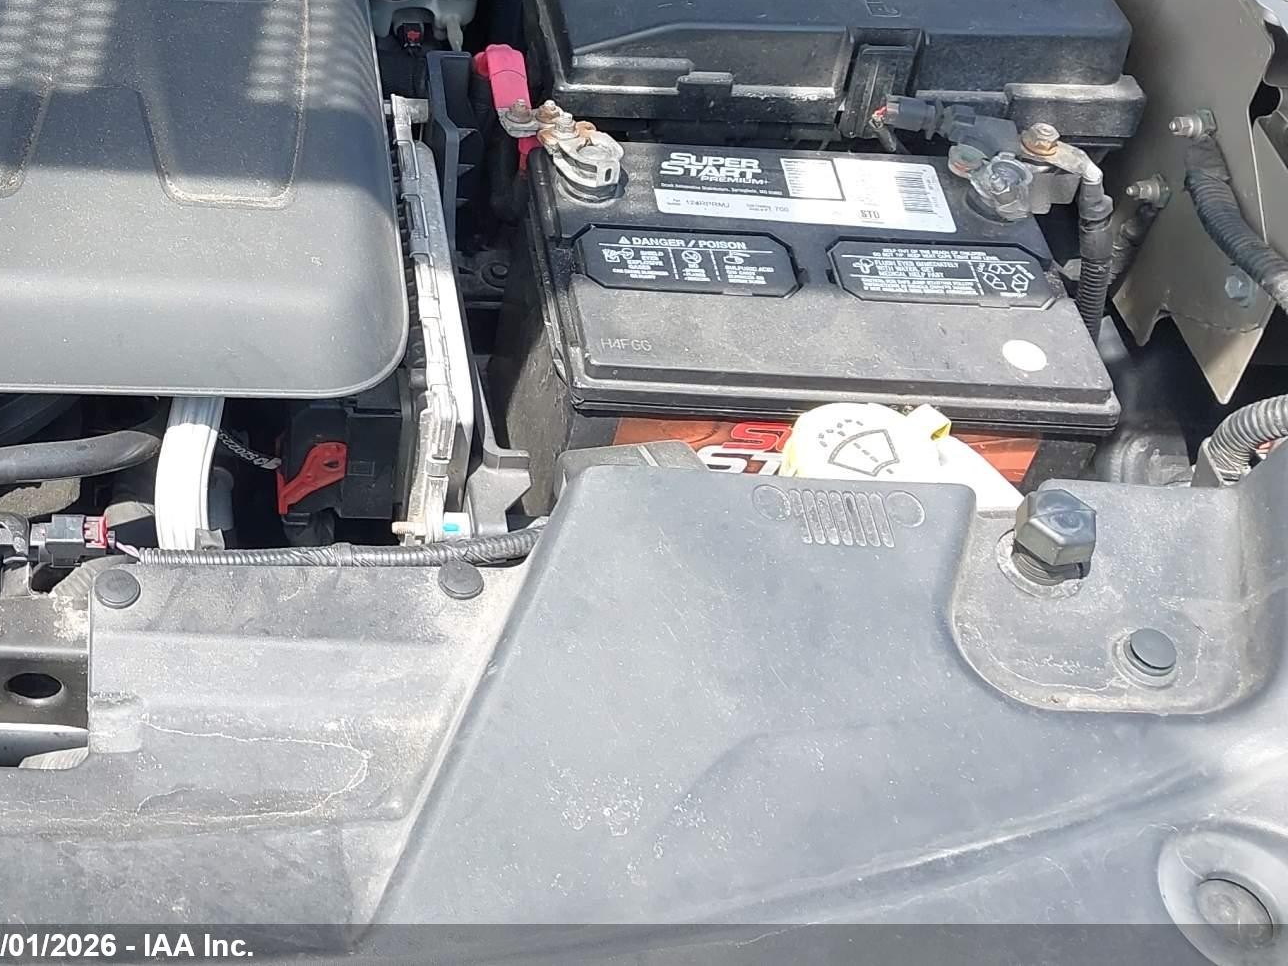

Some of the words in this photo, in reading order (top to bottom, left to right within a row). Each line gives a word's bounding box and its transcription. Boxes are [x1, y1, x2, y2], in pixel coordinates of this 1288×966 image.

[670, 152, 760, 169] SUPER
[659, 161, 762, 179] START
[632, 237, 686, 247] DANGER
[688, 239, 696, 248] /
[698, 240, 747, 249] POISON
